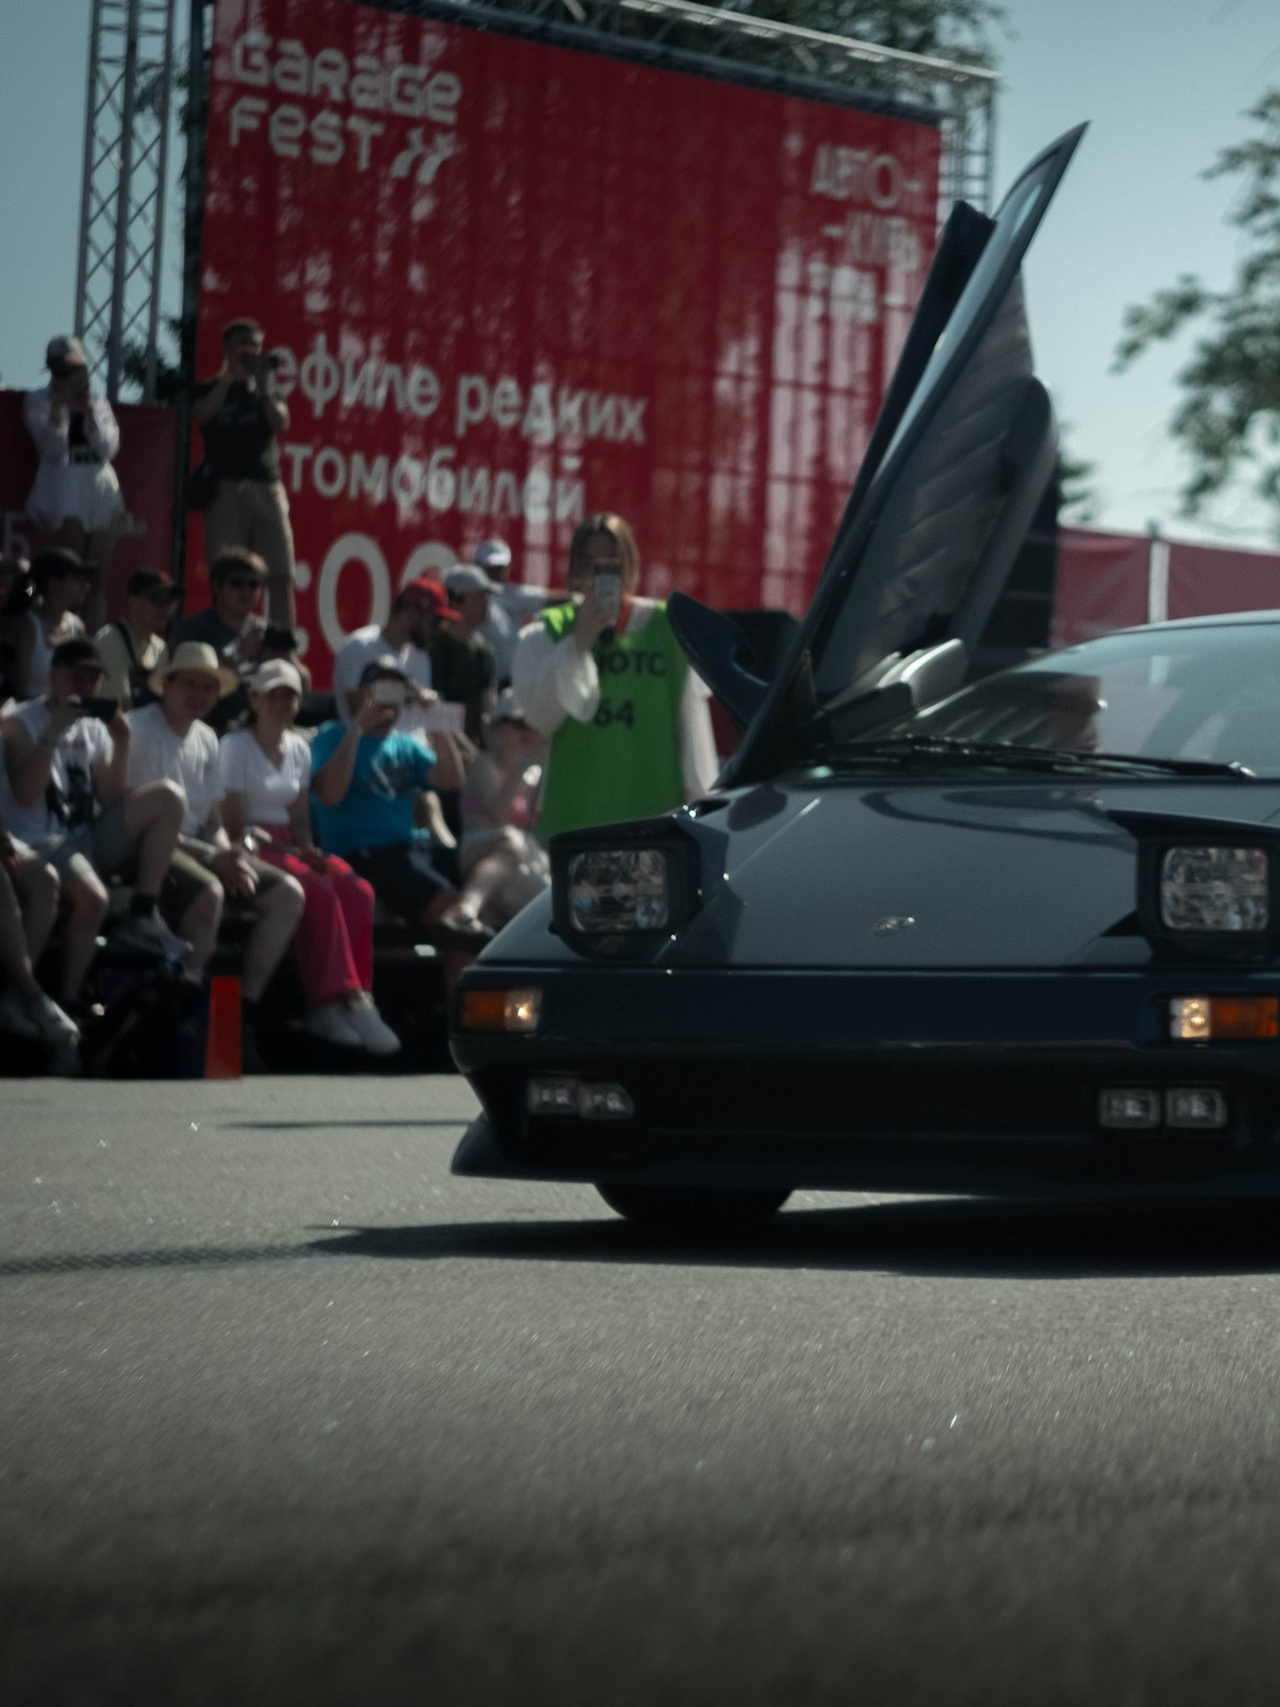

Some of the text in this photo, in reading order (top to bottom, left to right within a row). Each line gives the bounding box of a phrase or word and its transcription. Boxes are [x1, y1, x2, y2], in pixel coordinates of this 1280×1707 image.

[266, 333, 650, 445] ефиле редких
[284, 443, 586, 526] томобилей
